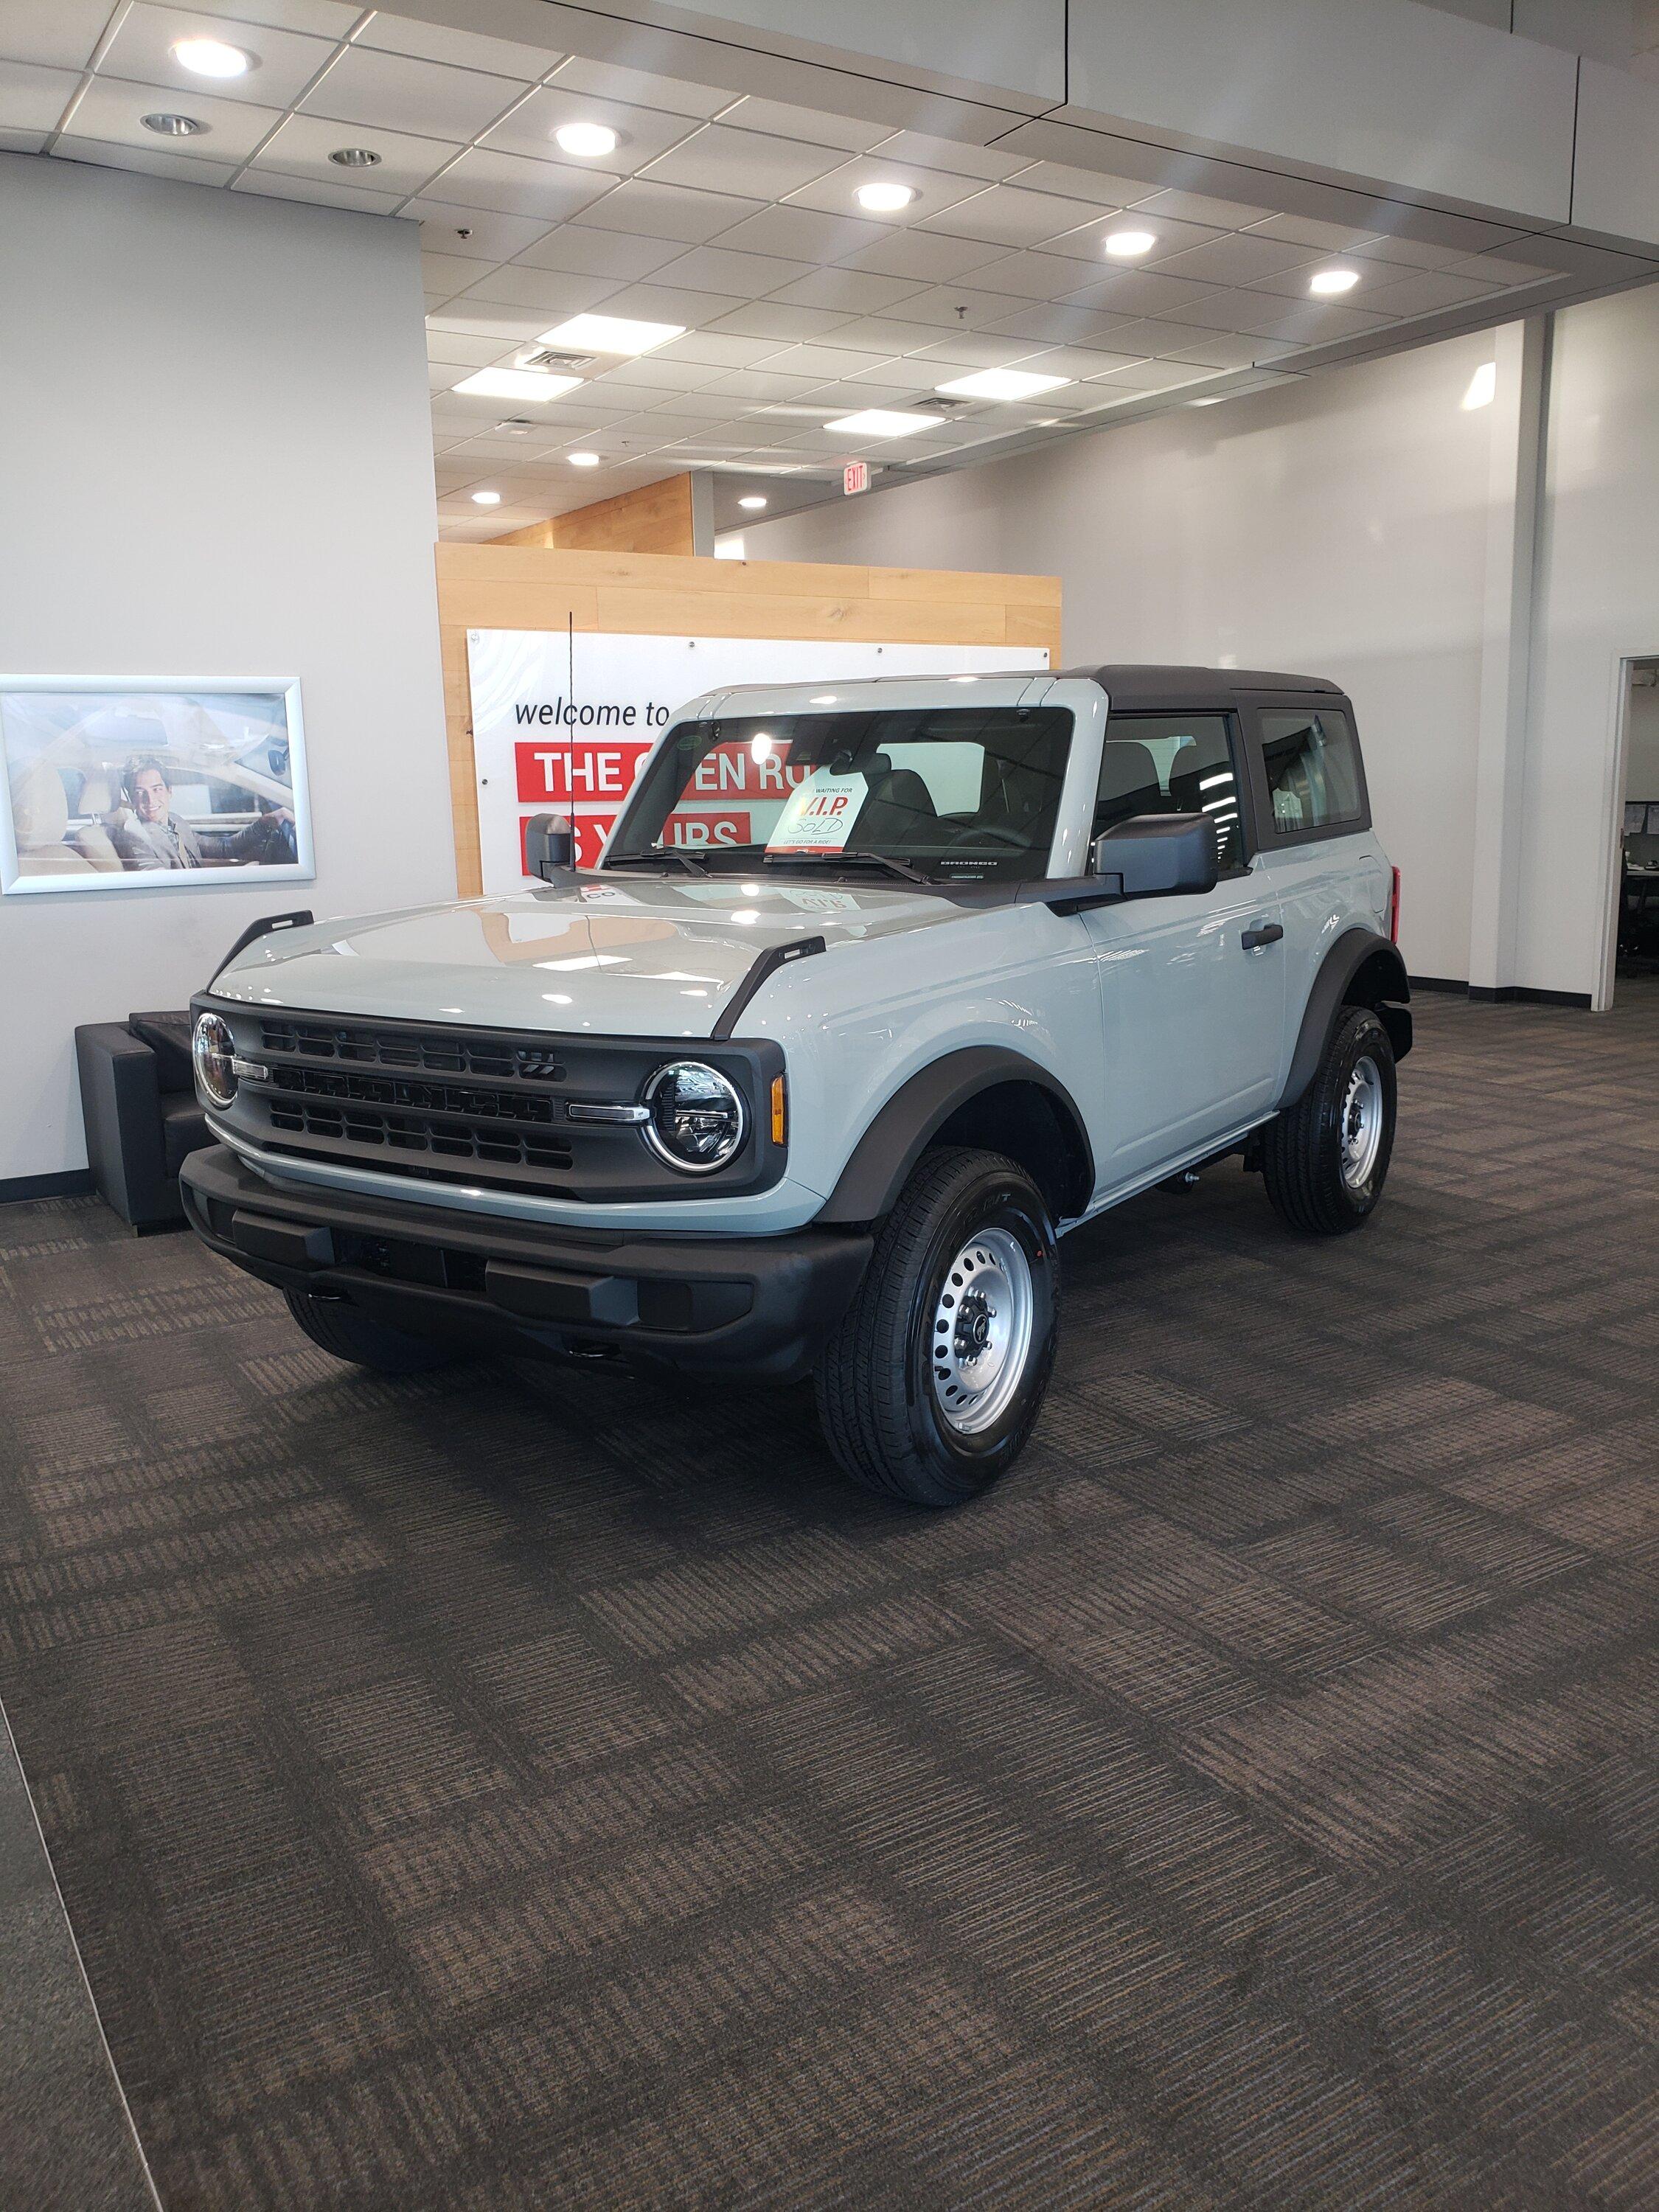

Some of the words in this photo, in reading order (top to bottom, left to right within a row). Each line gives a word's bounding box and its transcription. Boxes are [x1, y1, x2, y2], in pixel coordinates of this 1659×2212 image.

[846, 465, 863, 492] EXIT
[515, 696, 636, 726] welcome
[646, 702, 670, 726] to
[534, 752, 623, 792] THE
